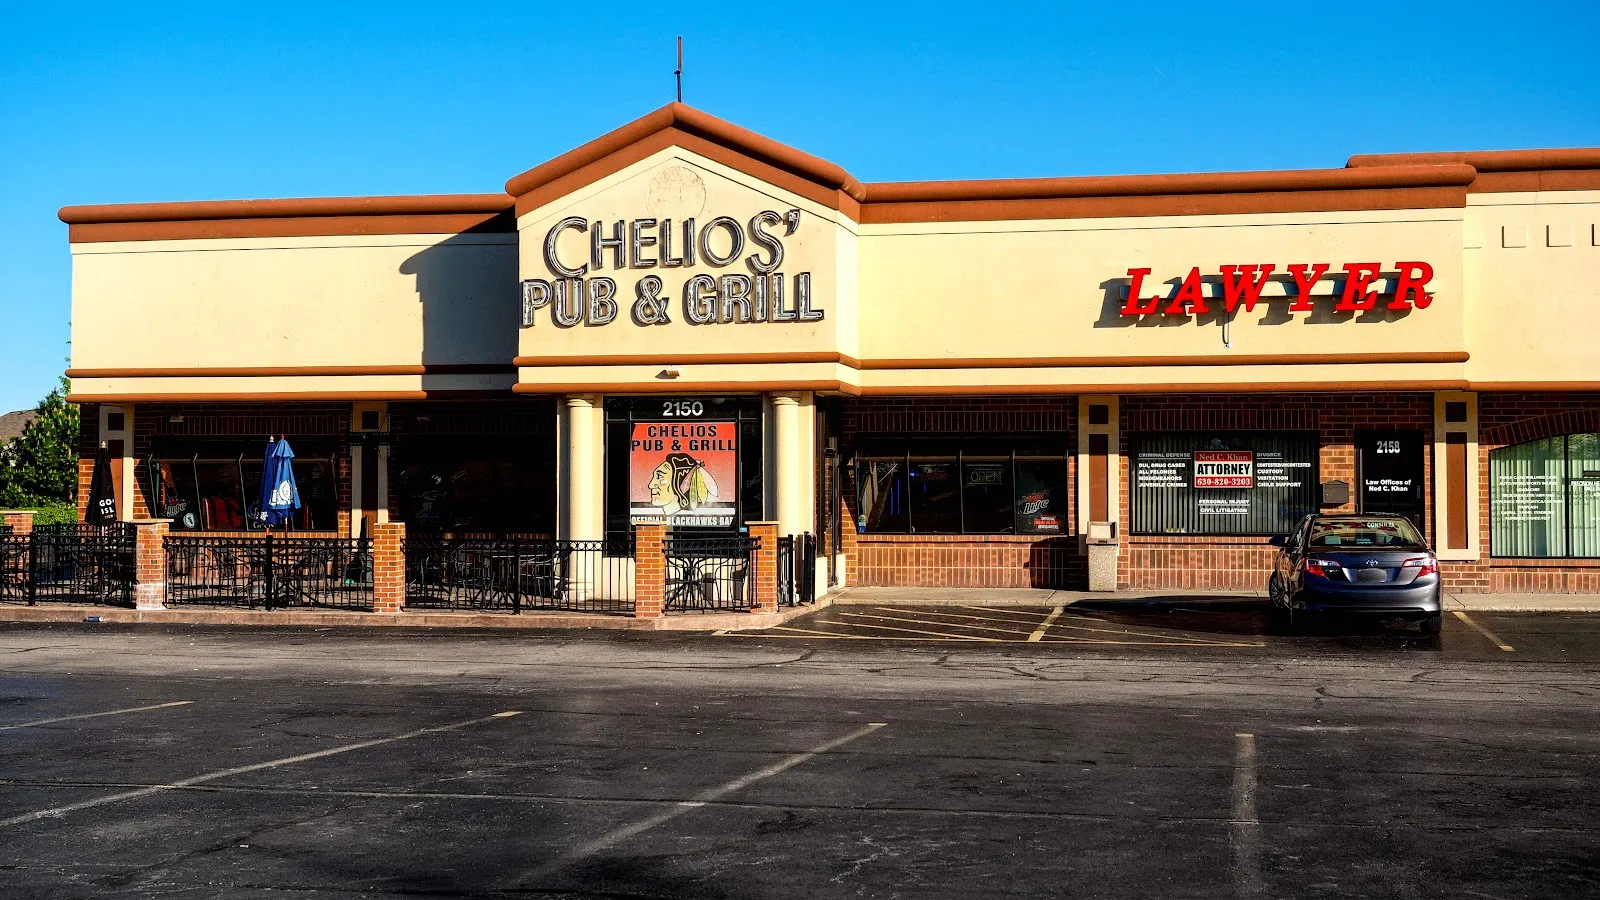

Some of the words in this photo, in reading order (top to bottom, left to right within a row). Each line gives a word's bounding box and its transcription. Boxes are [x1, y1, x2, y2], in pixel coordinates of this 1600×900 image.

[545, 209, 801, 277] CHELIOS'
[1121, 261, 1434, 316] LAWYER
[522, 277, 617, 327] PUB
[633, 275, 671, 327] &
[684, 272, 825, 325] GRILL
[662, 401, 704, 416] 2150
[647, 425, 717, 438] CHELIOS
[631, 439, 664, 452] PUB
[671, 439, 682, 451] &
[689, 439, 736, 451] GRILL
[1376, 440, 1401, 454] 2158
[1199, 453, 1215, 461] Ned
[1216, 453, 1225, 461] C.
[1227, 453, 1248, 461] Khan
[1197, 463, 1251, 475] ATTORNEY
[970, 470, 1002, 482] OPEN
[1197, 477, 1251, 486] 630-820-3203
[667, 516, 718, 526] BLACKHAWKS
